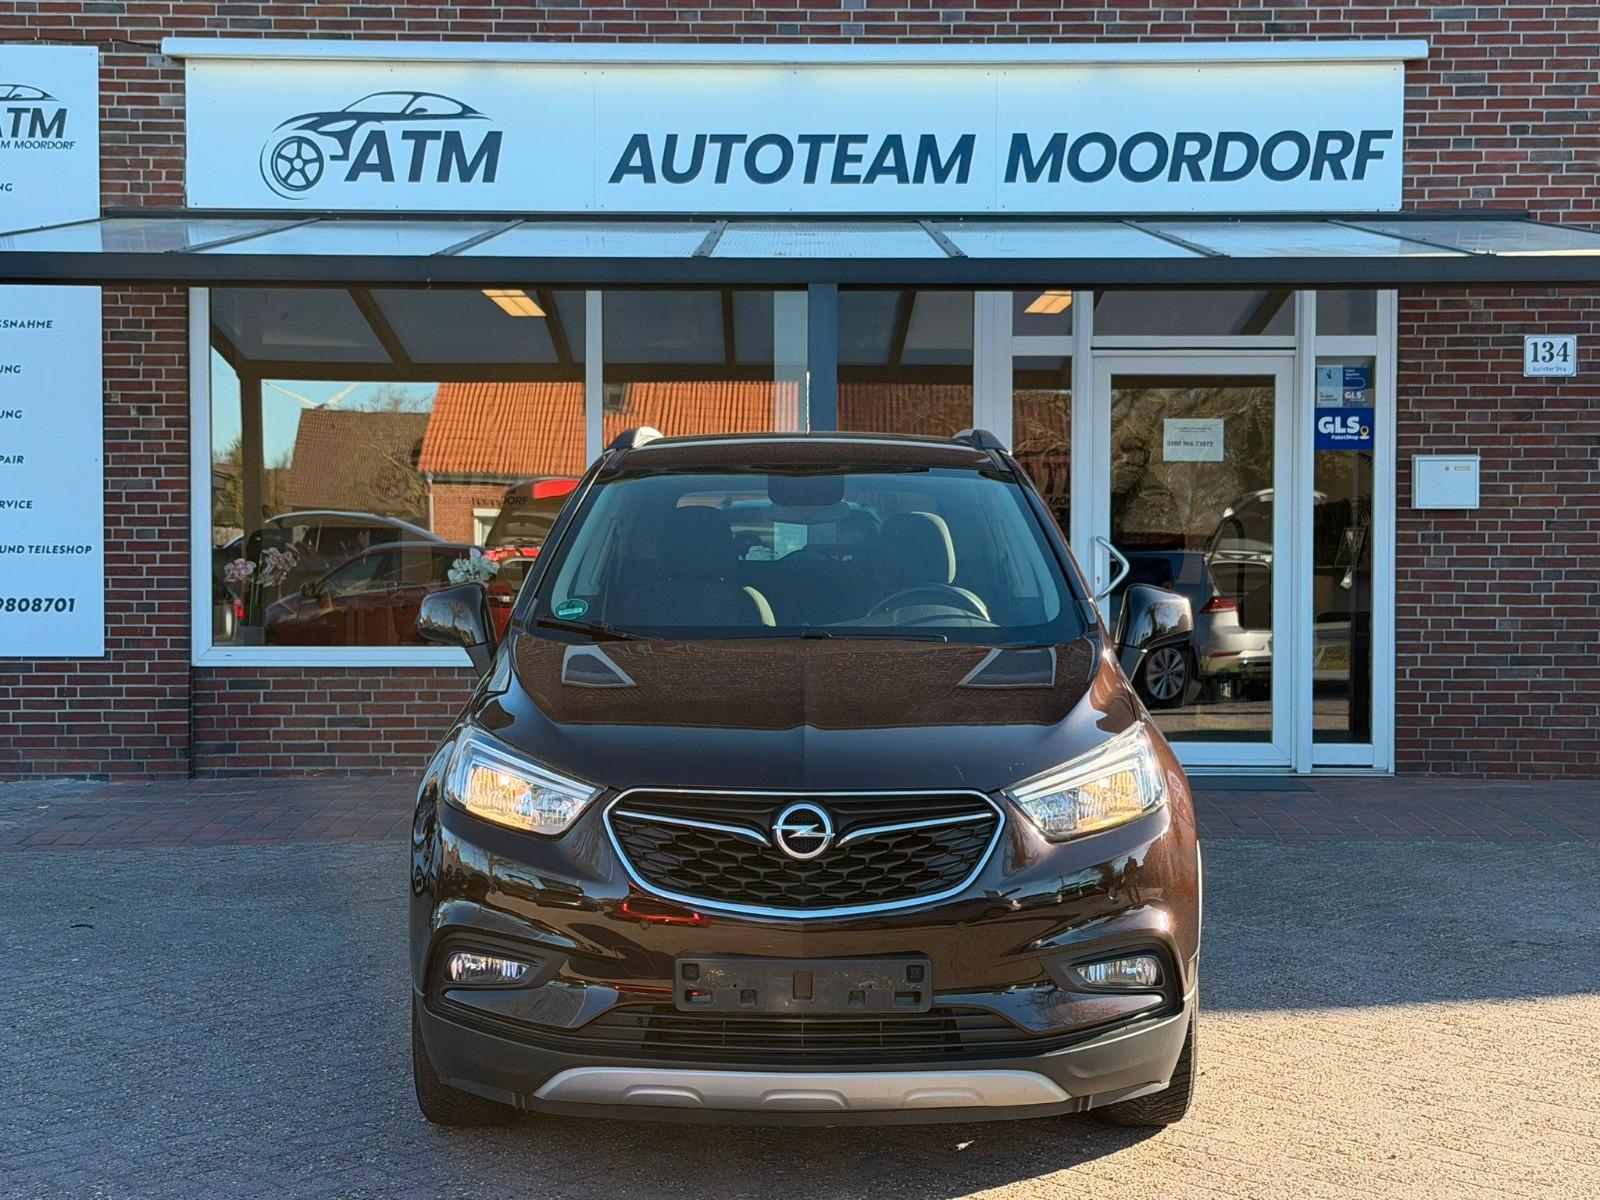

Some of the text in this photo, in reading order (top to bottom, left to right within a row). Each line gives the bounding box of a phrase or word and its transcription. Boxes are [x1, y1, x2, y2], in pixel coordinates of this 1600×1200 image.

[0, 107, 68, 139] TM
[14, 140, 77, 150] MOORDORF
[344, 129, 503, 183] ATM
[608, 128, 1394, 185] AUTOTEAM MOORDORF
[0, 319, 53, 329] SNAHME
[1530, 341, 1570, 363] 134
[1318, 416, 1360, 434] GLS
[28, 545, 92, 555] TEILESHOP
